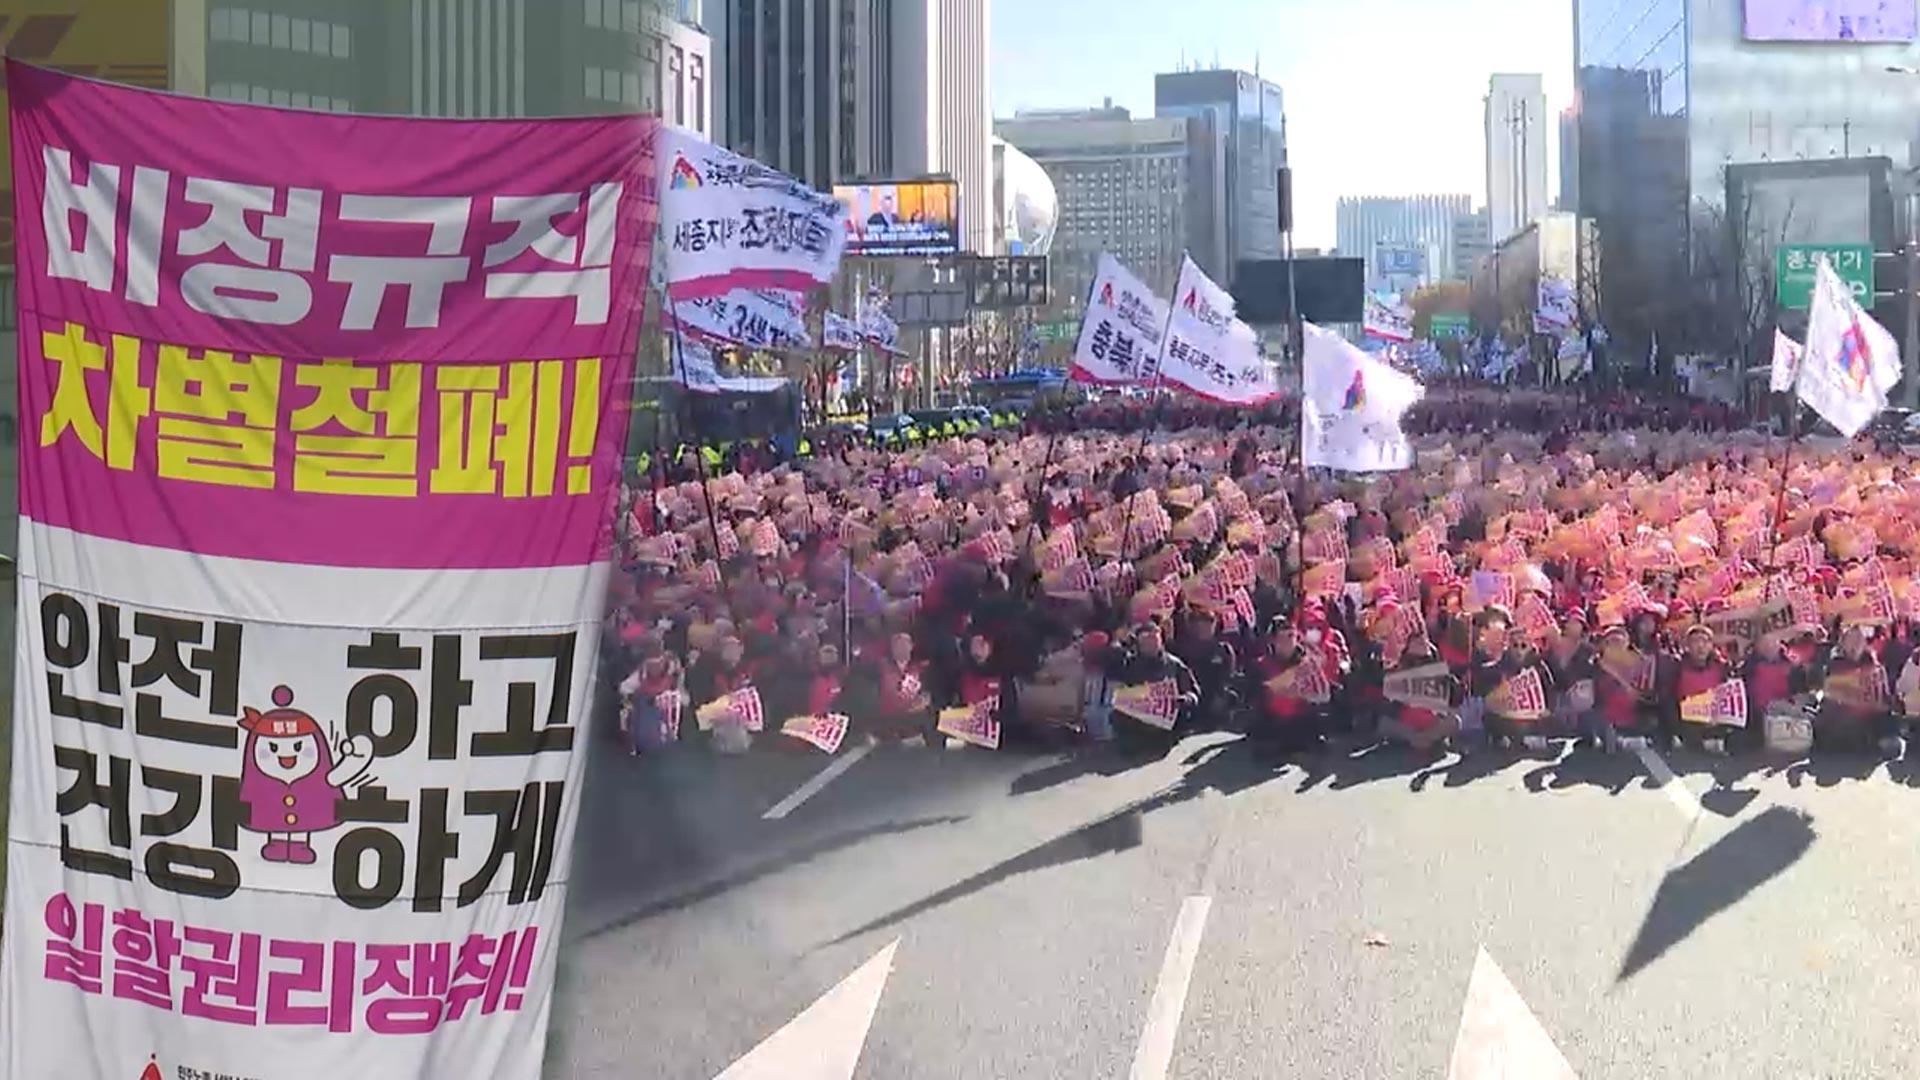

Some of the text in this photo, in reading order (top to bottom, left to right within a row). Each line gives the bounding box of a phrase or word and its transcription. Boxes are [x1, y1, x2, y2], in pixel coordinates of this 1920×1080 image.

[42, 144, 624, 330] 비정규직
[40, 321, 602, 498] 차별철폐!
[40, 592, 578, 761] 안전 하고
[55, 745, 565, 913] 건강 하게
